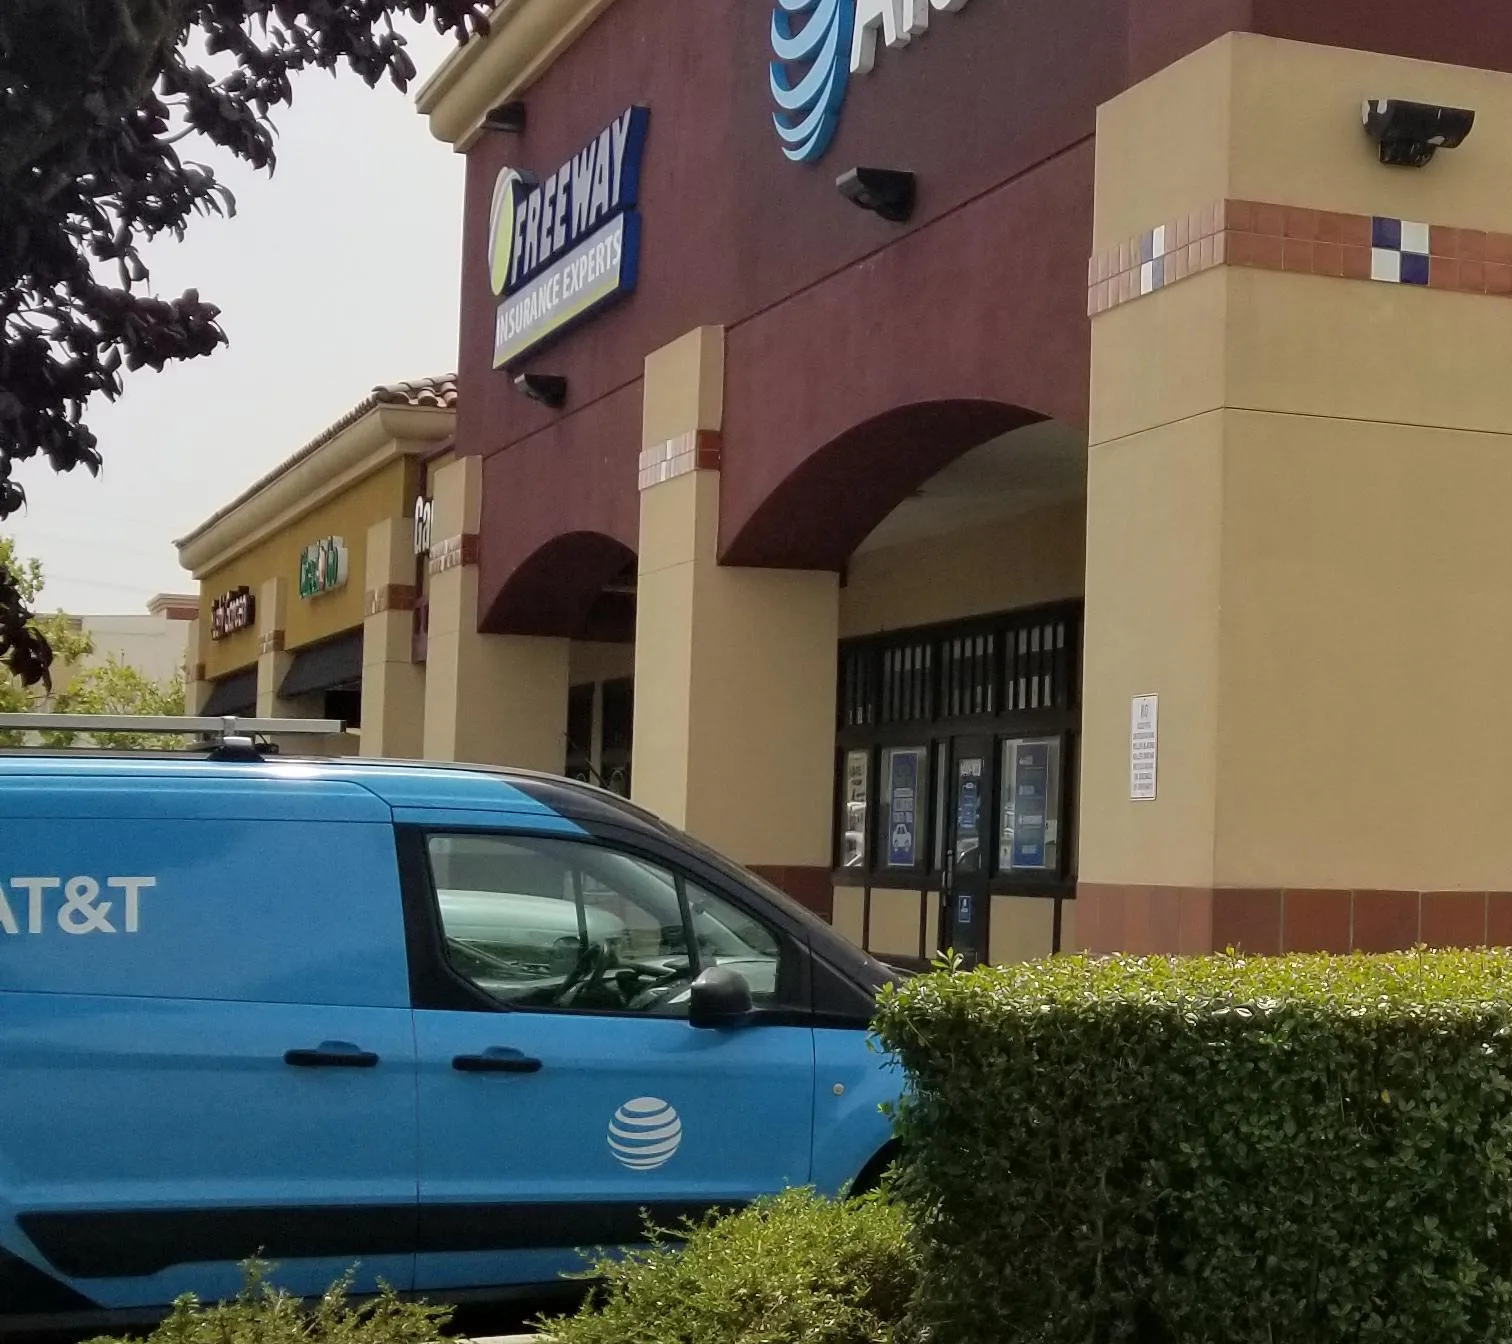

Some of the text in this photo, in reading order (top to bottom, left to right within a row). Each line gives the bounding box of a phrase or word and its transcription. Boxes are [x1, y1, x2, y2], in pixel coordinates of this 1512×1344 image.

[510, 107, 632, 286] FREEWAY
[495, 229, 622, 348] INSURANCE EXPERTS
[414, 495, 434, 555] Ga
